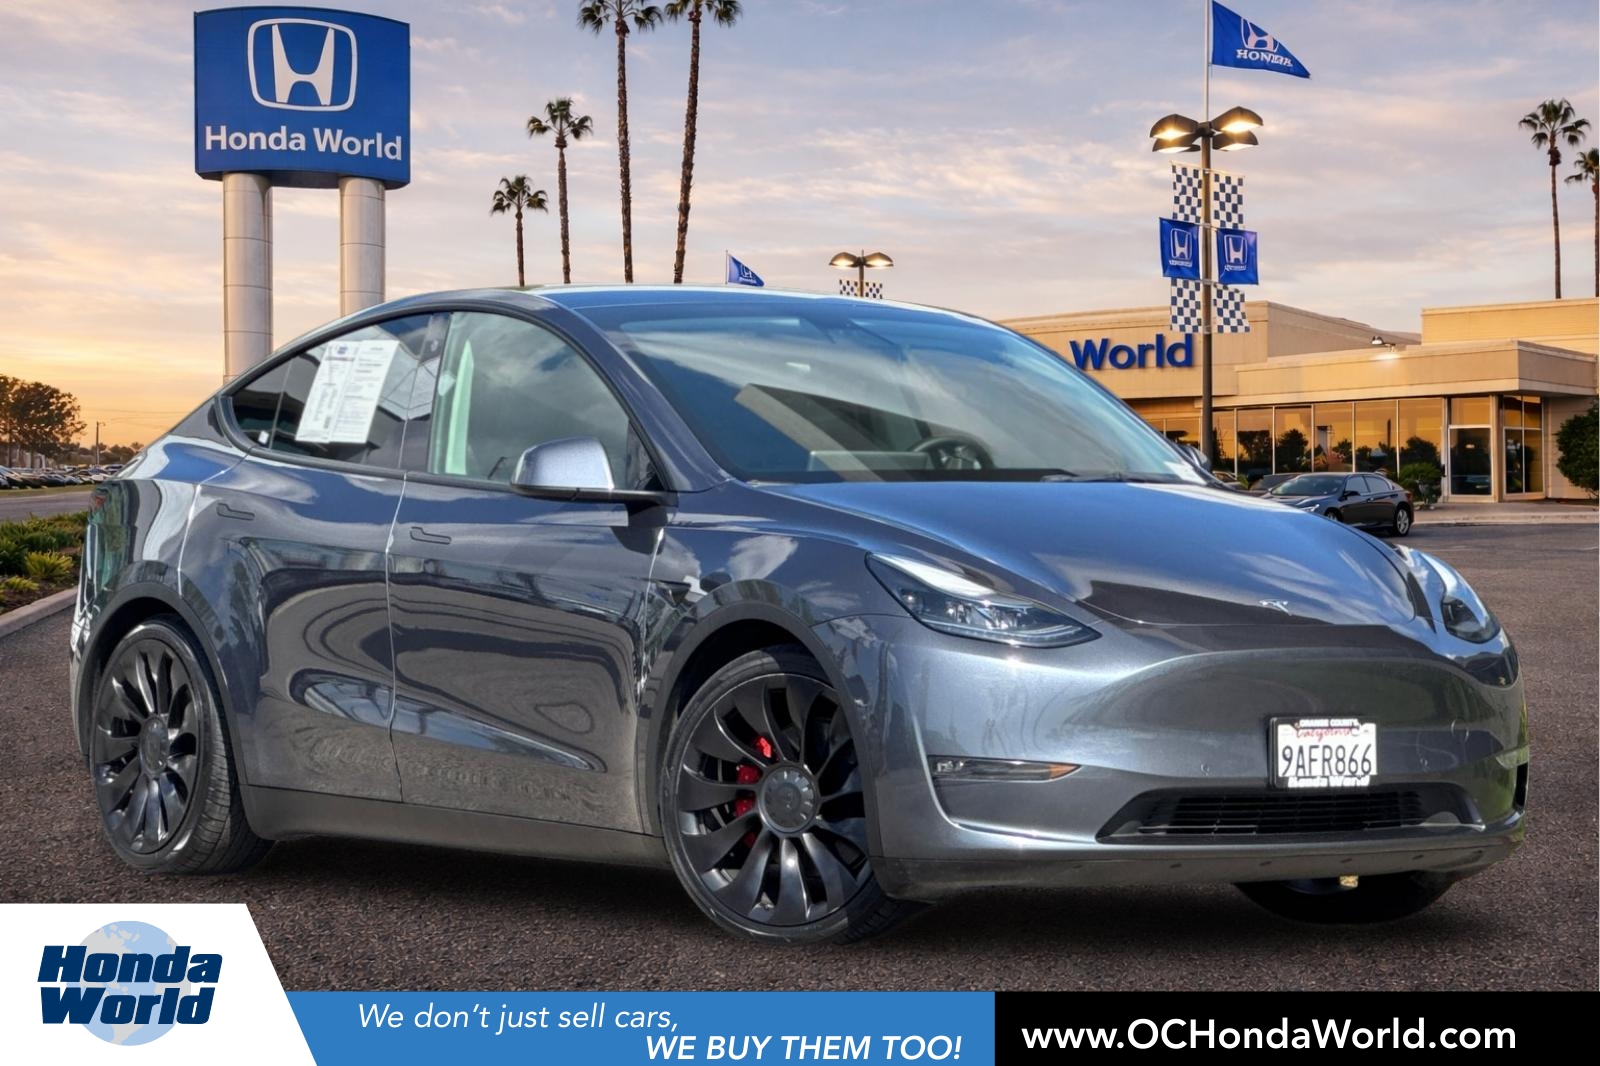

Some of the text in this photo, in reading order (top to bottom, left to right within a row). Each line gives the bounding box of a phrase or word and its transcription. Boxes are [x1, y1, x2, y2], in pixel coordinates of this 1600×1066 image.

[205, 125, 402, 160] Honda World
[1069, 333, 1193, 371] World
[1282, 744, 1372, 777] 9AFR866
